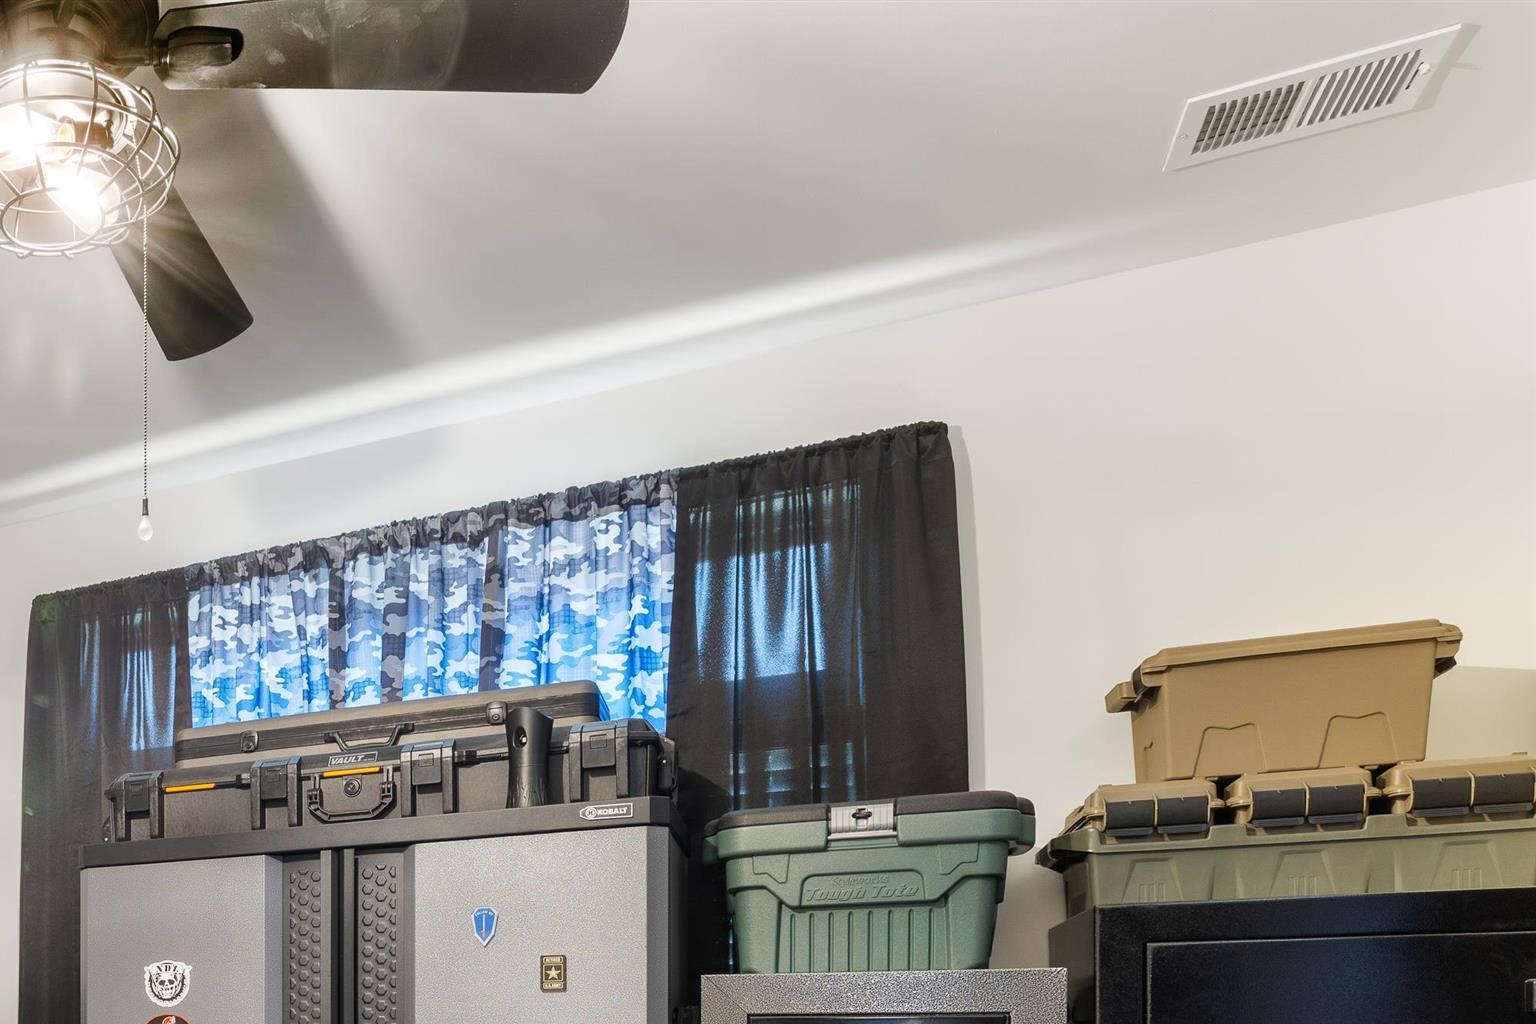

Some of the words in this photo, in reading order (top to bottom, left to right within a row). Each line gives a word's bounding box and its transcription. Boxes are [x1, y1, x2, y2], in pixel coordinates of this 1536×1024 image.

[331, 755, 365, 765] VAULT
[597, 807, 628, 816] KOBALT
[807, 887, 867, 902] Tough
[872, 884, 920, 899] Tote
